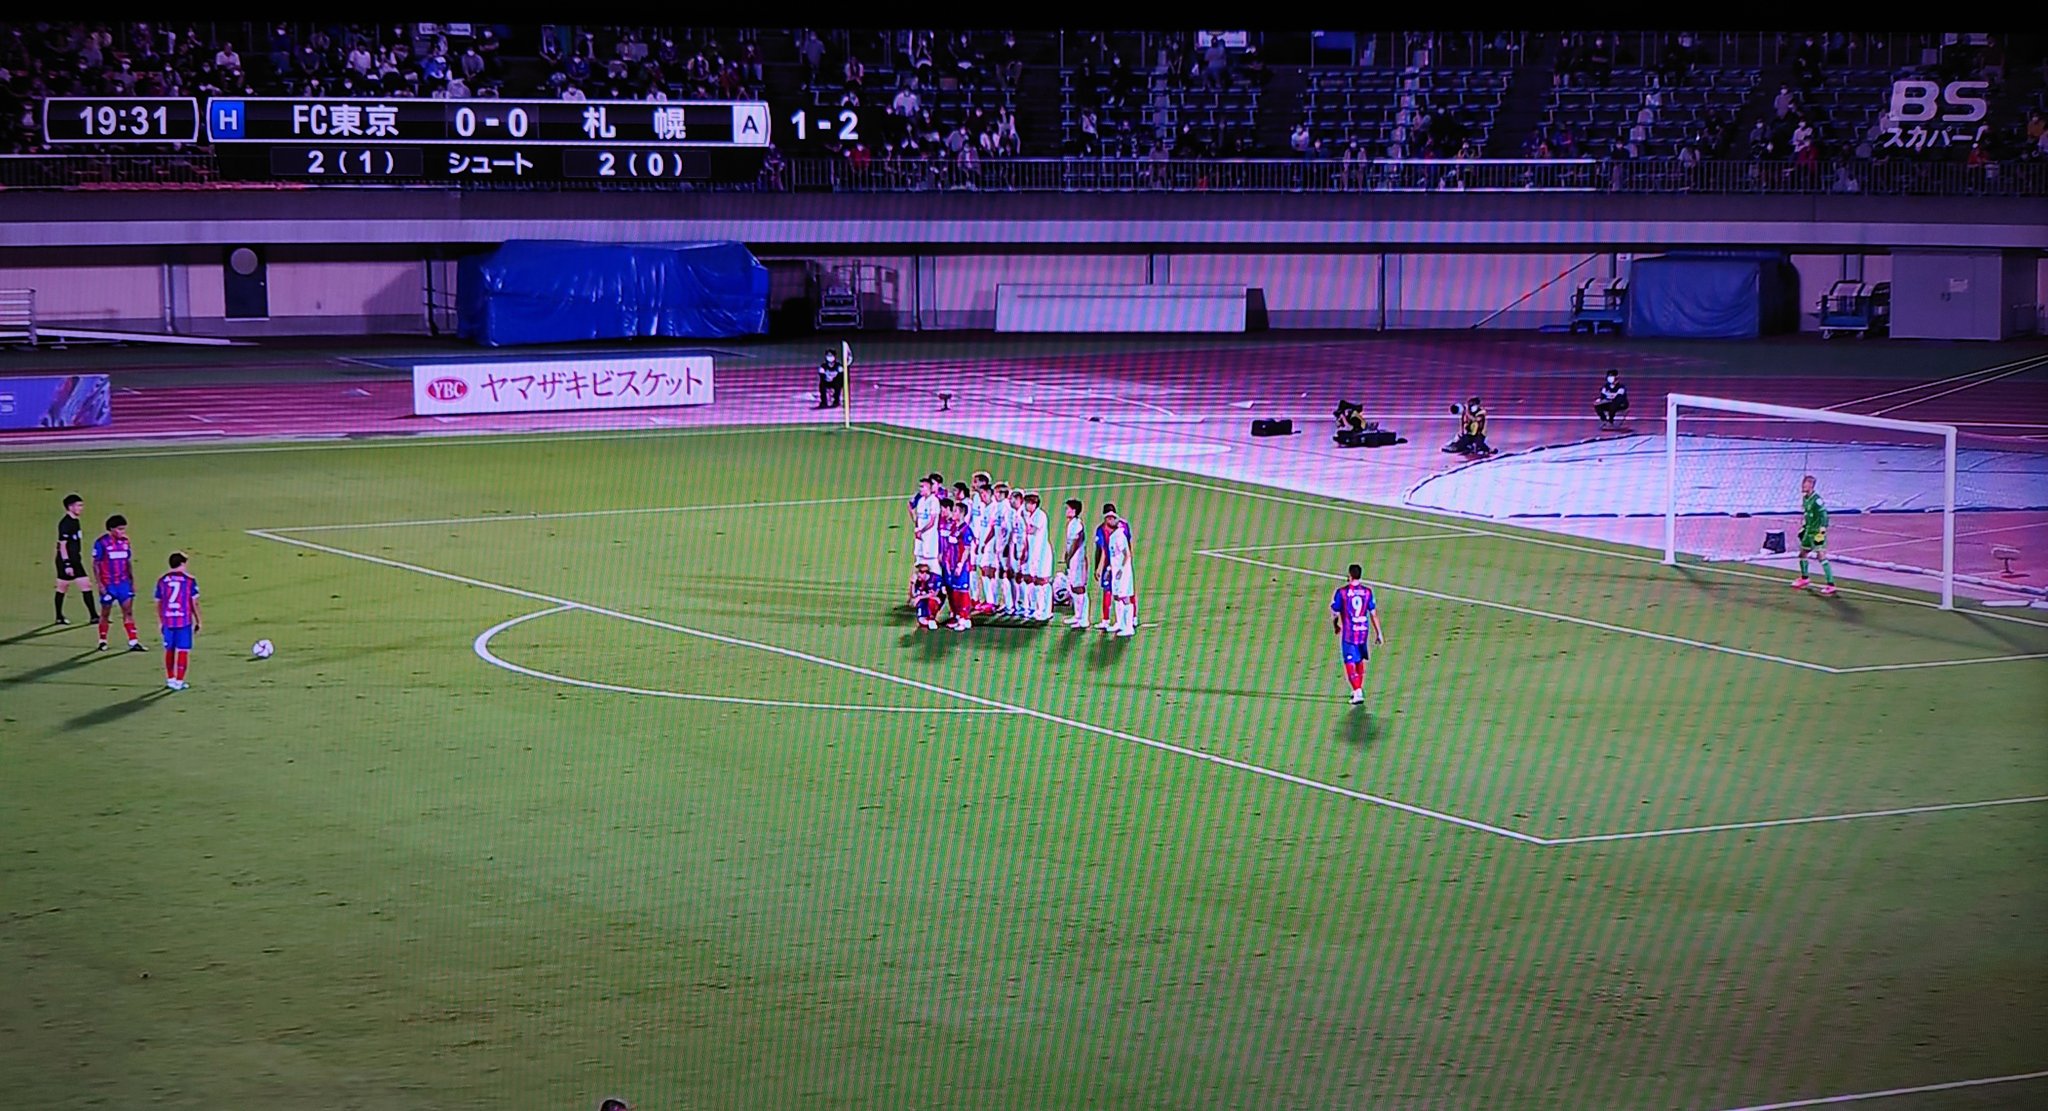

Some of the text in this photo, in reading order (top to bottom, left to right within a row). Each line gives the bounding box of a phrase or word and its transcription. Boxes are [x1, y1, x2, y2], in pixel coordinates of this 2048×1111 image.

[1890, 81, 1989, 121] BS
[79, 106, 168, 135] 19:31
[219, 110, 238, 130] H
[292, 104, 400, 137] FC東京
[742, 113, 759, 134] A
[448, 152, 534, 175] シュート
[433, 381, 465, 399] YBC
[480, 367, 704, 402] ヤマザキビスケット
[168, 581, 181, 603] 7
[1351, 596, 1363, 617] 9
